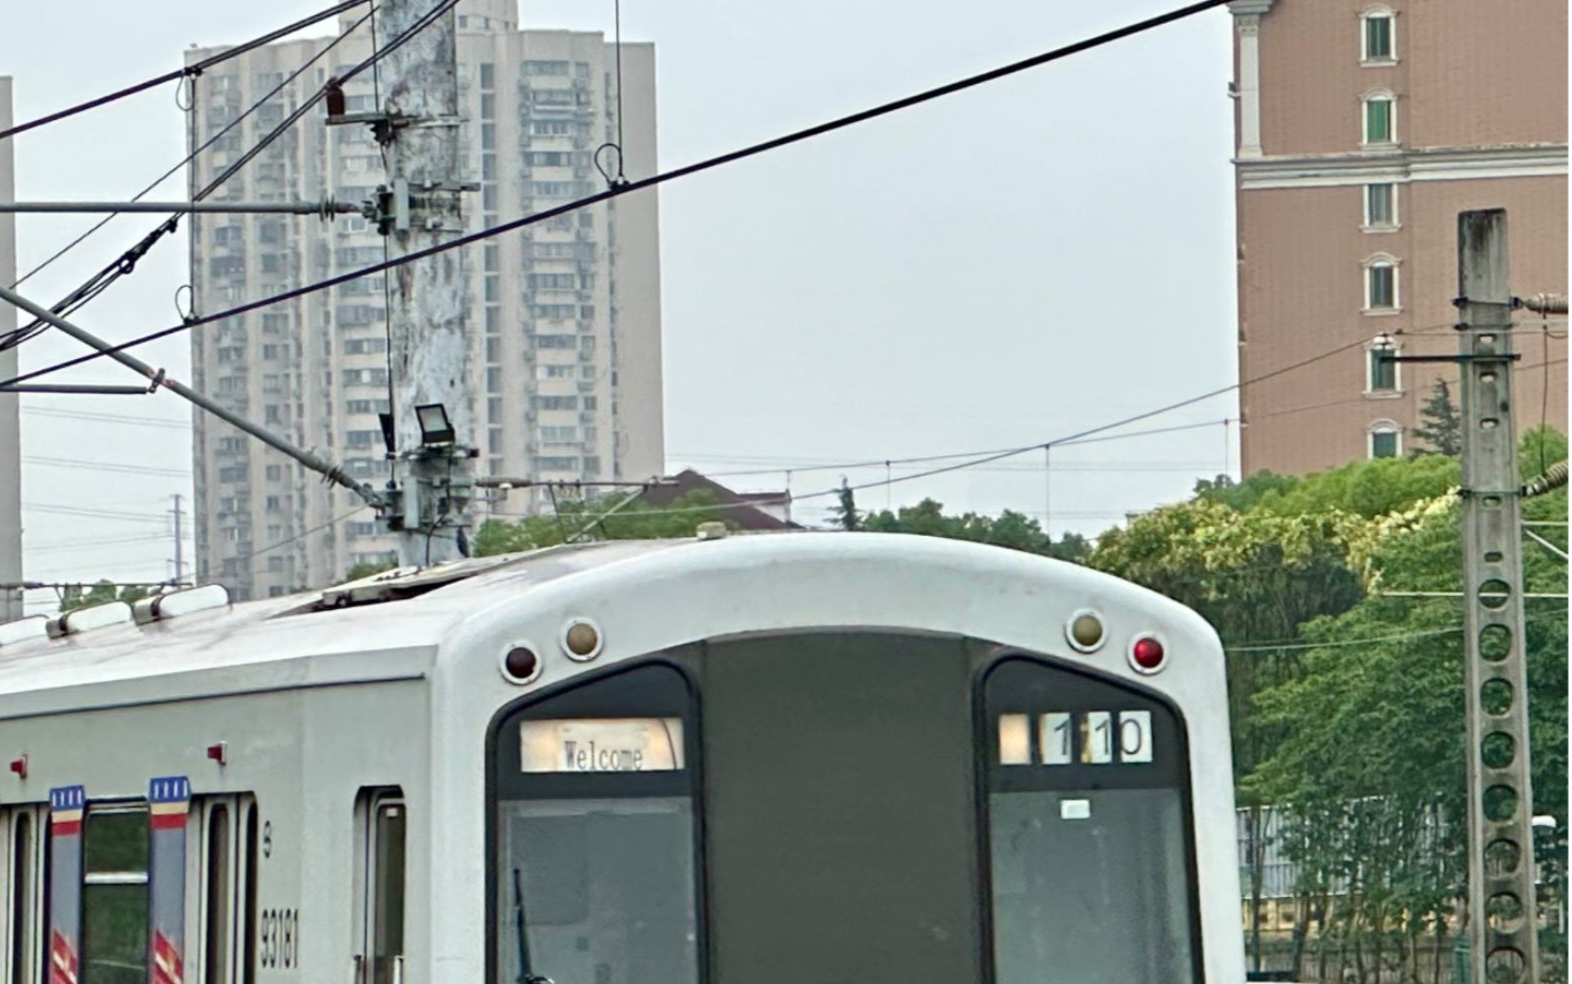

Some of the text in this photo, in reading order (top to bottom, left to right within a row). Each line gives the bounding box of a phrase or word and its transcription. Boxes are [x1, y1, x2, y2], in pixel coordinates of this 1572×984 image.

[563, 740, 644, 770] Welcome
[1053, 718, 1143, 756] 110
[260, 907, 299, 969] 93181
